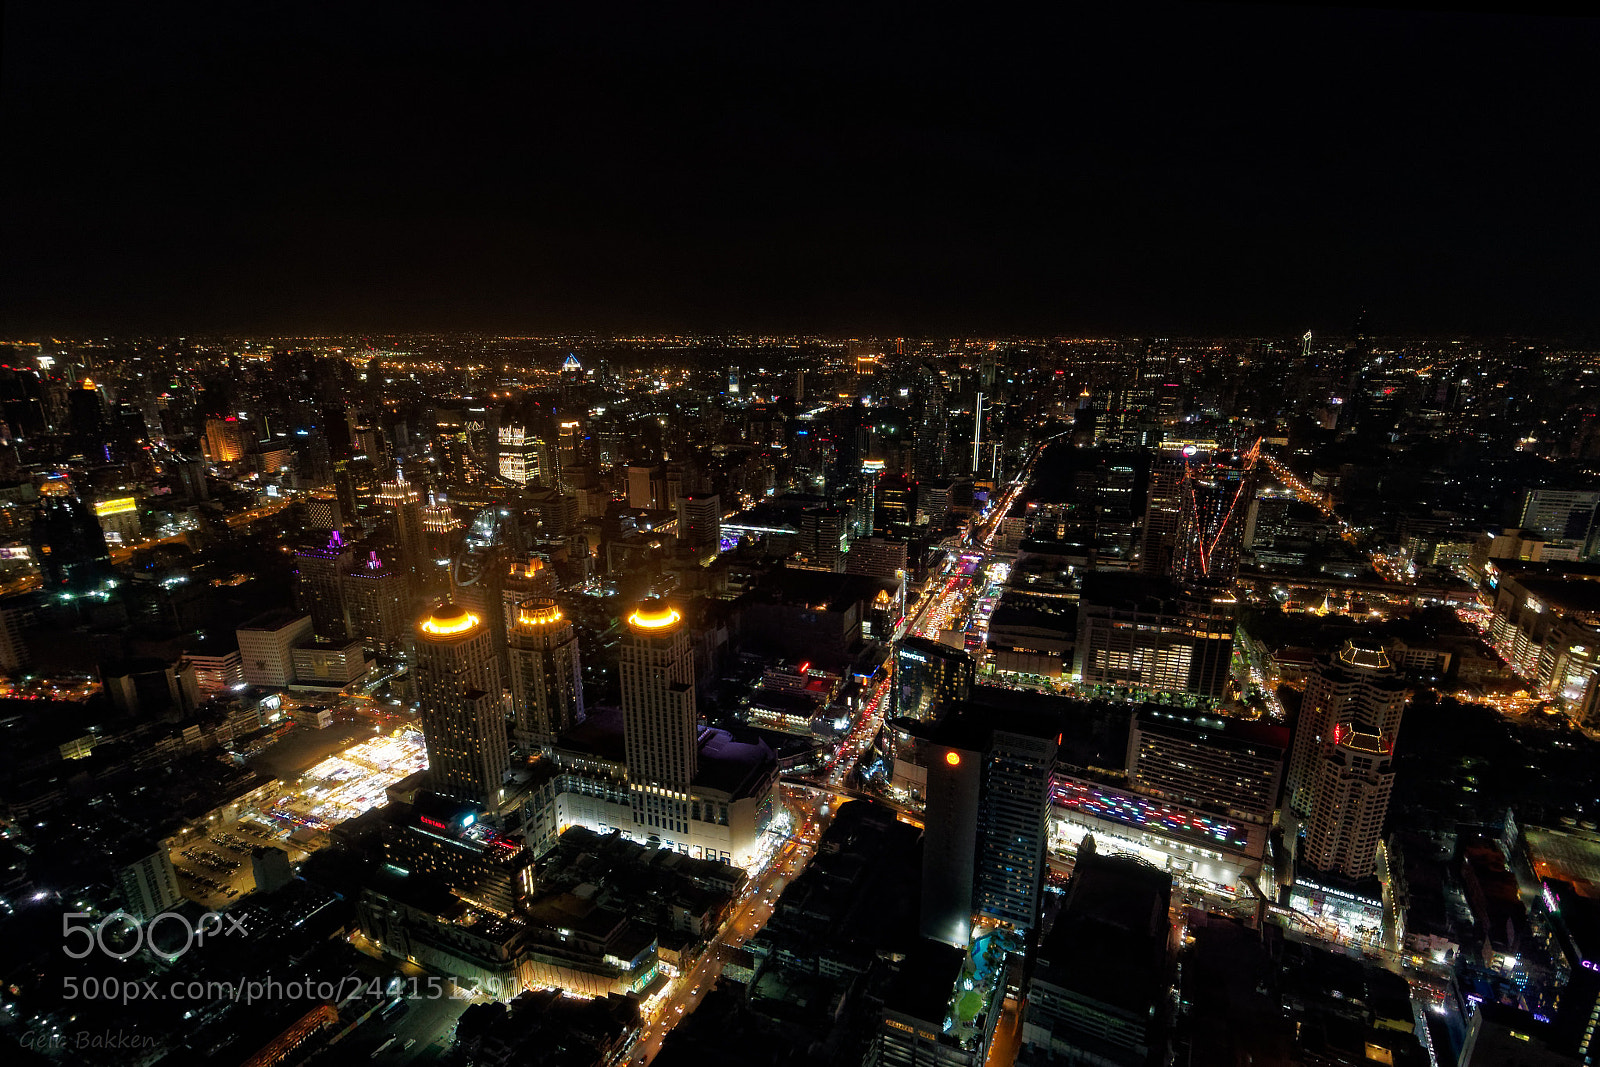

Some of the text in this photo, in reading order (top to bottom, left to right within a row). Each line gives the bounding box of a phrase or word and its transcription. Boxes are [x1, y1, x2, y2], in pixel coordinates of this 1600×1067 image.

[1295, 879, 1383, 908] GRAND DIAMOND PLAZA
